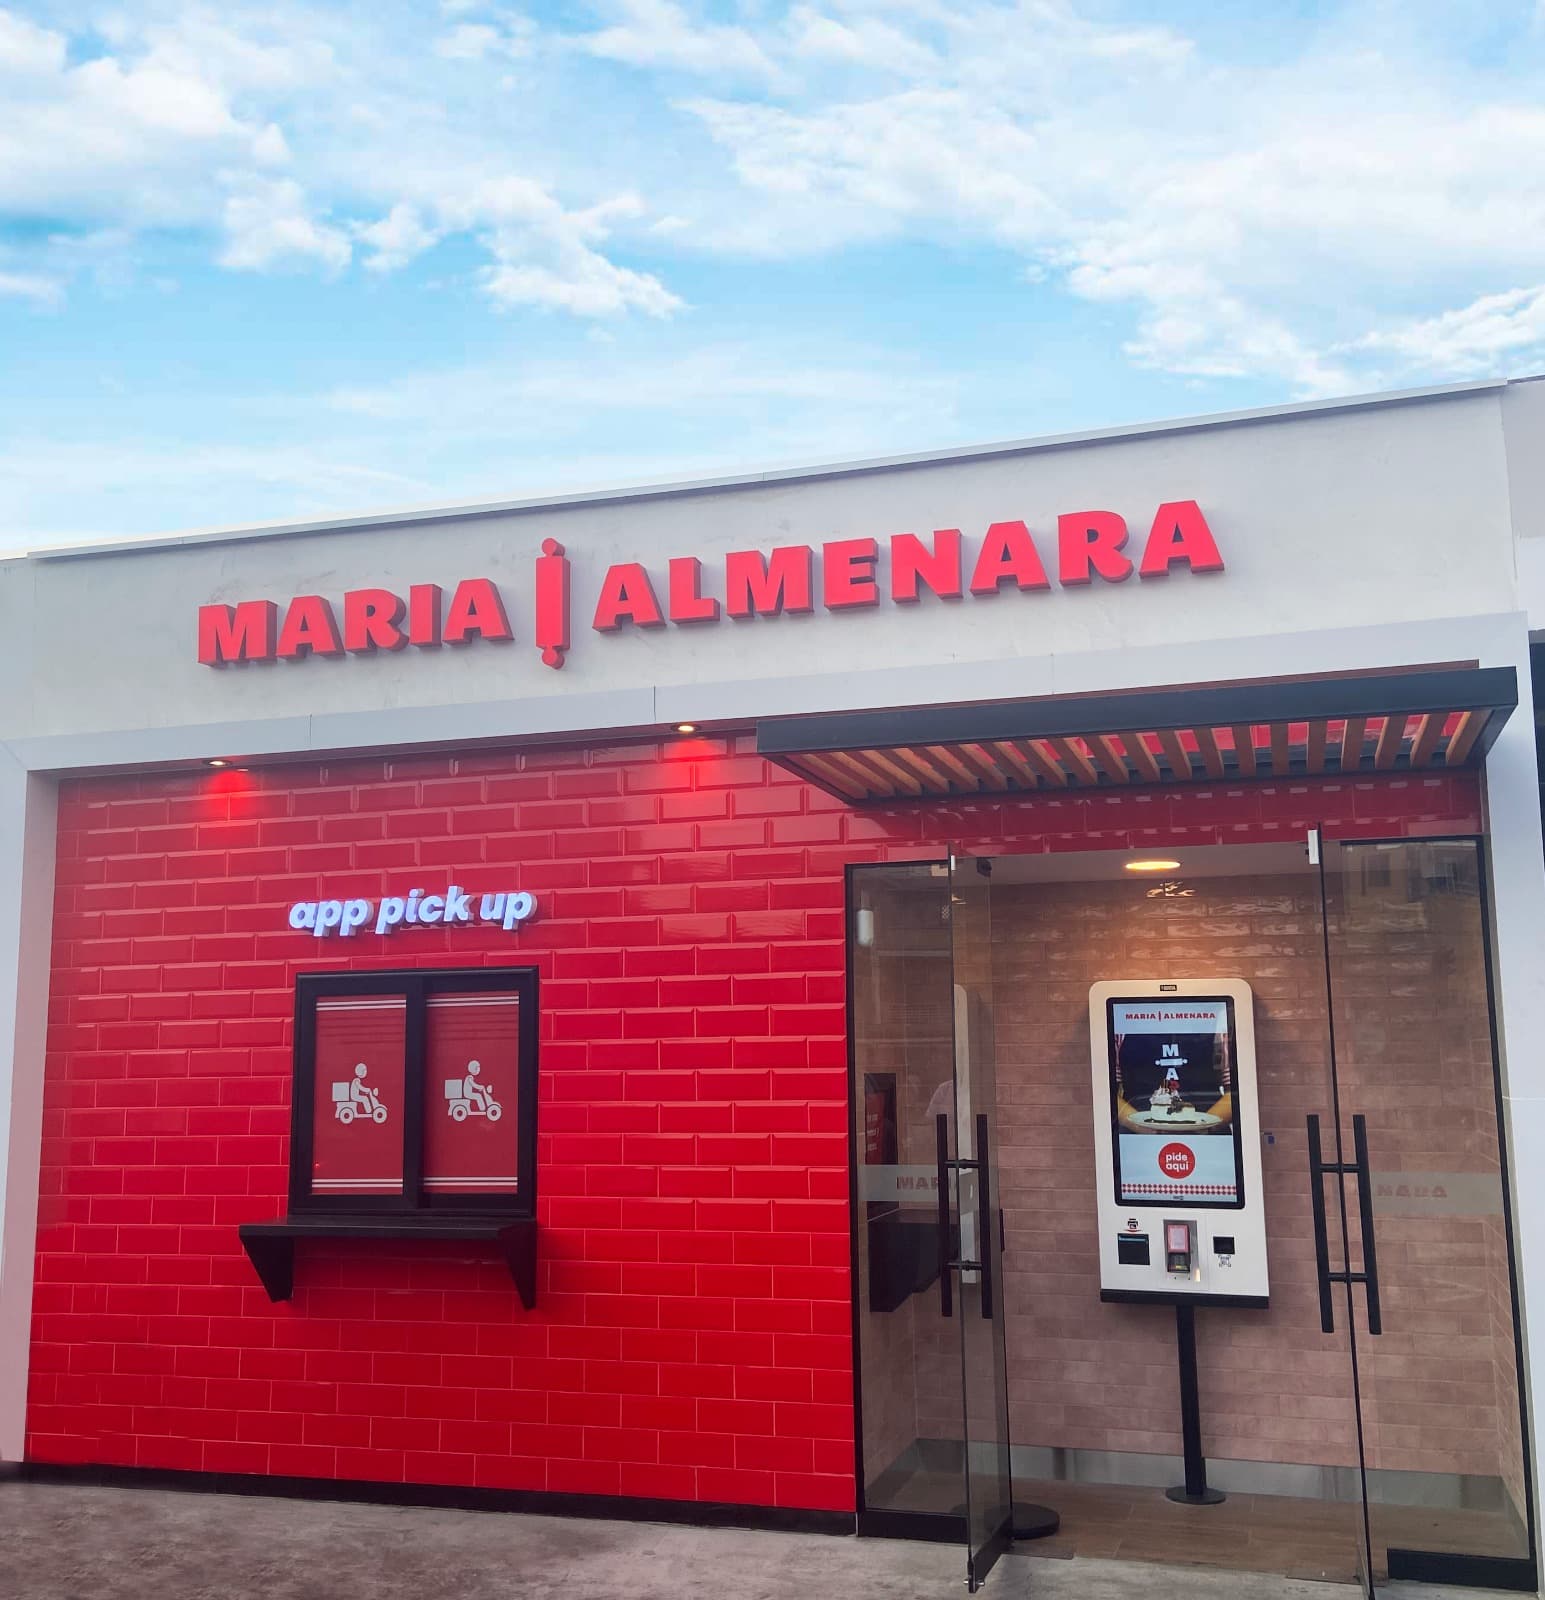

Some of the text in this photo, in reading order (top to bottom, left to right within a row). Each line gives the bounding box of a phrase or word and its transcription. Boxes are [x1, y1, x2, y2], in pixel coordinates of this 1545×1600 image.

[198, 499, 1224, 667] MARIA ALMENARA
[288, 885, 538, 937] app pick up
[1125, 1012, 1216, 1021] MARIA ALMENARA
[1165, 1152, 1188, 1163] pide
